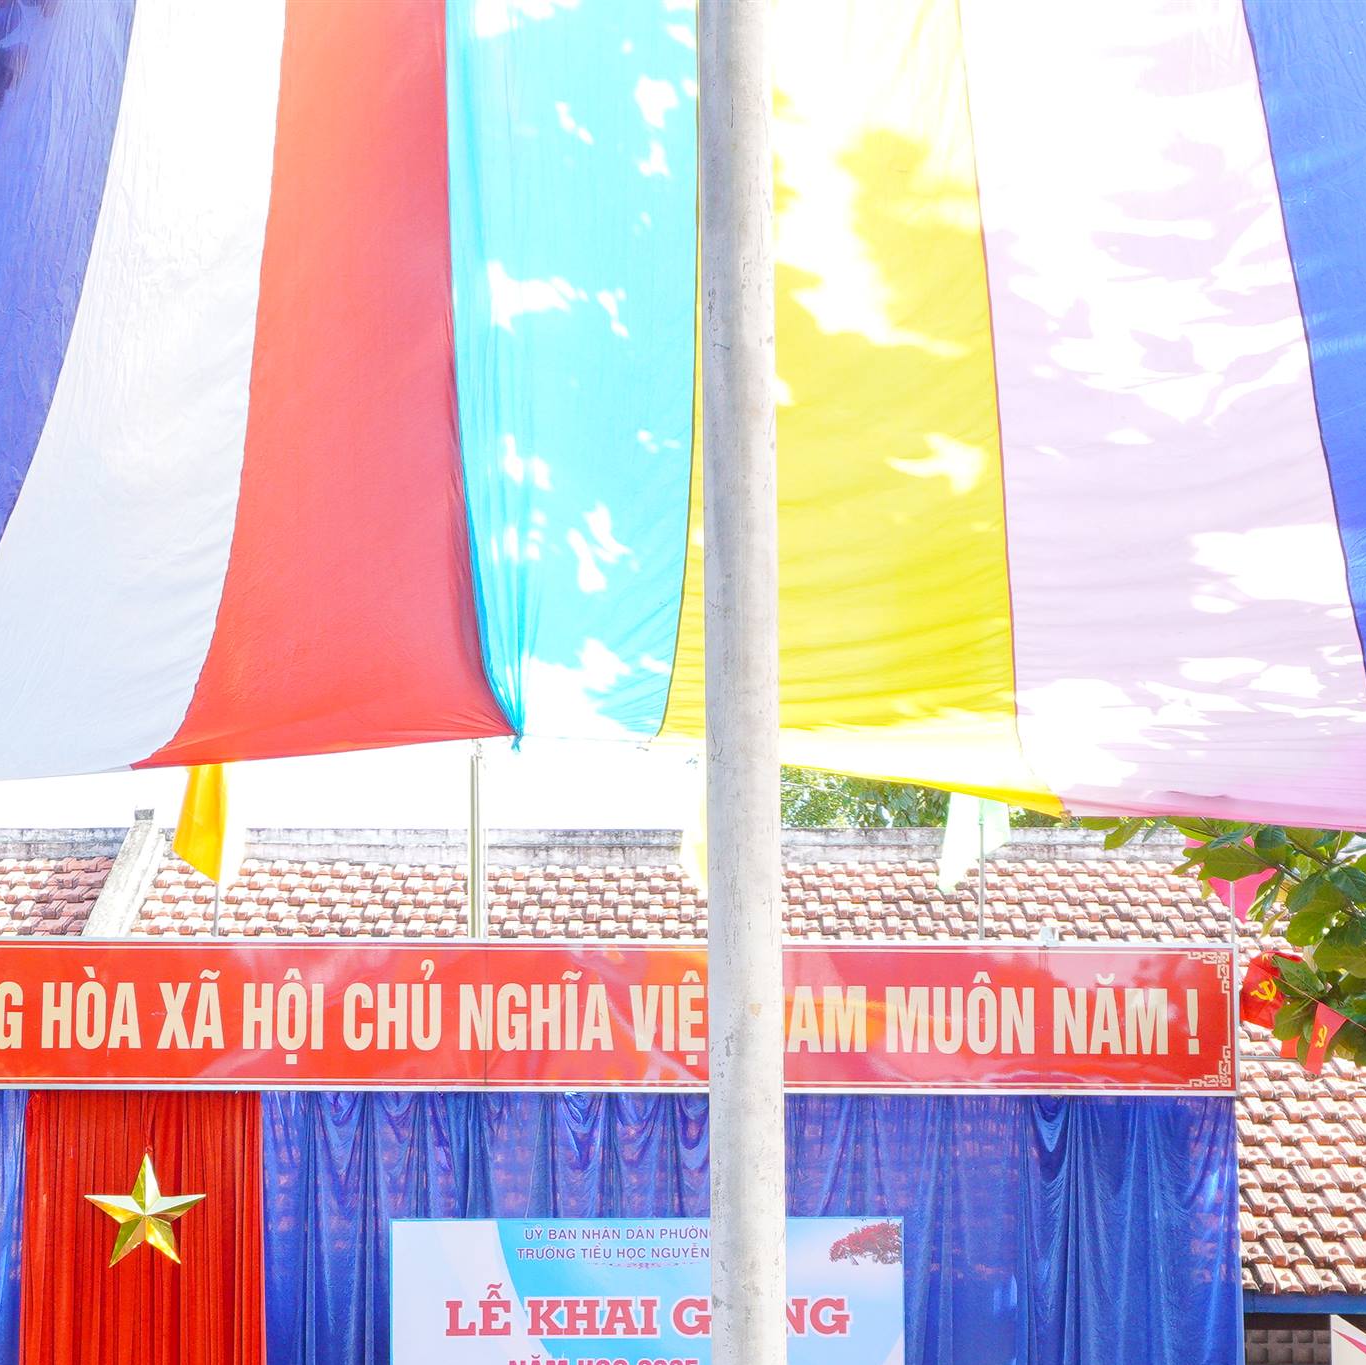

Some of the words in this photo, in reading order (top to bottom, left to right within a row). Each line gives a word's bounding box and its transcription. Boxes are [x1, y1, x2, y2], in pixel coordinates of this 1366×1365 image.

[40, 966, 143, 1050] HÒA
[157, 969, 225, 1050] XÃ
[242, 970, 324, 1065] HỘI
[342, 959, 442, 1052] CHỦ
[459, 970, 613, 1052] NGHĨA
[628, 970, 707, 1066] VIỆ
[783, 985, 867, 1053] AM
[886, 971, 1036, 1055] MUÔN
[1053, 971, 1169, 1055] NĂM
[517, 1246, 576, 1260] TRƯỜNG
[581, 1242, 612, 1259] TIỂU
[616, 1247, 646, 1260] HỌC
[651, 1243, 710, 1259] NGUYỄN
[548, 1228, 577, 1241] BAN
[581, 1226, 620, 1240] NHÂN
[626, 1226, 654, 1240] DÂN
[659, 1225, 712, 1240] PHƯỜN
[445, 1282, 511, 1336] LỄ
[527, 1299, 657, 1336] KHAI
[672, 1297, 850, 1336] GNG
